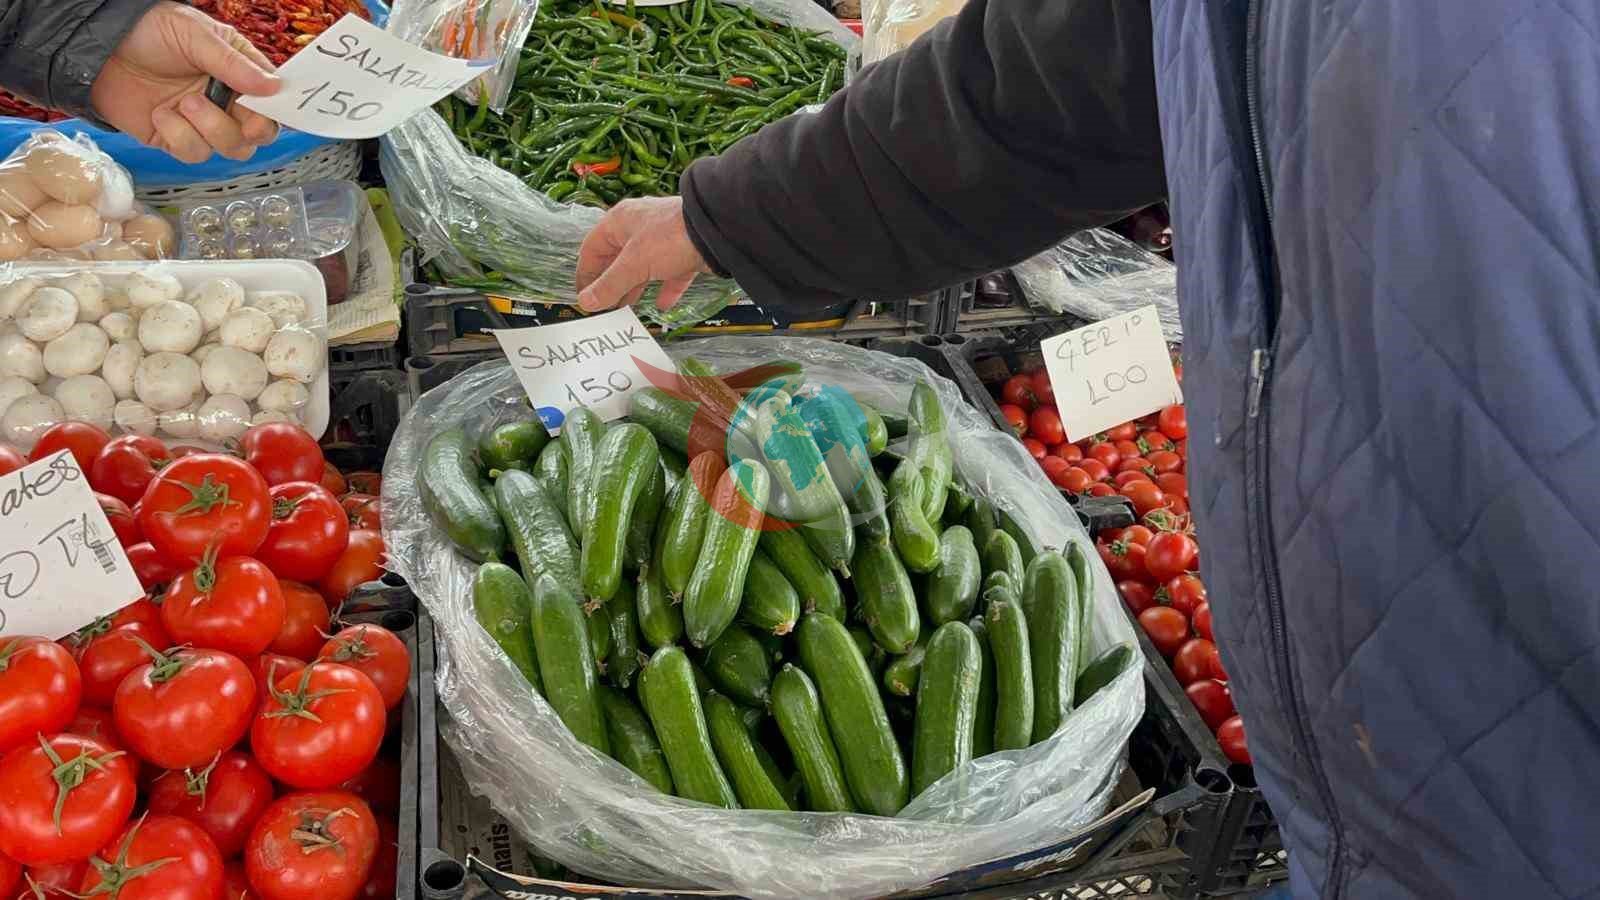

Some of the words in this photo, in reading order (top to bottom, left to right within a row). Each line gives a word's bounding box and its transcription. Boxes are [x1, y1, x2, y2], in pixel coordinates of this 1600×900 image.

[297, 81, 384, 122] 150
[518, 327, 650, 370] SALATALIK
[564, 370, 633, 408] 150
